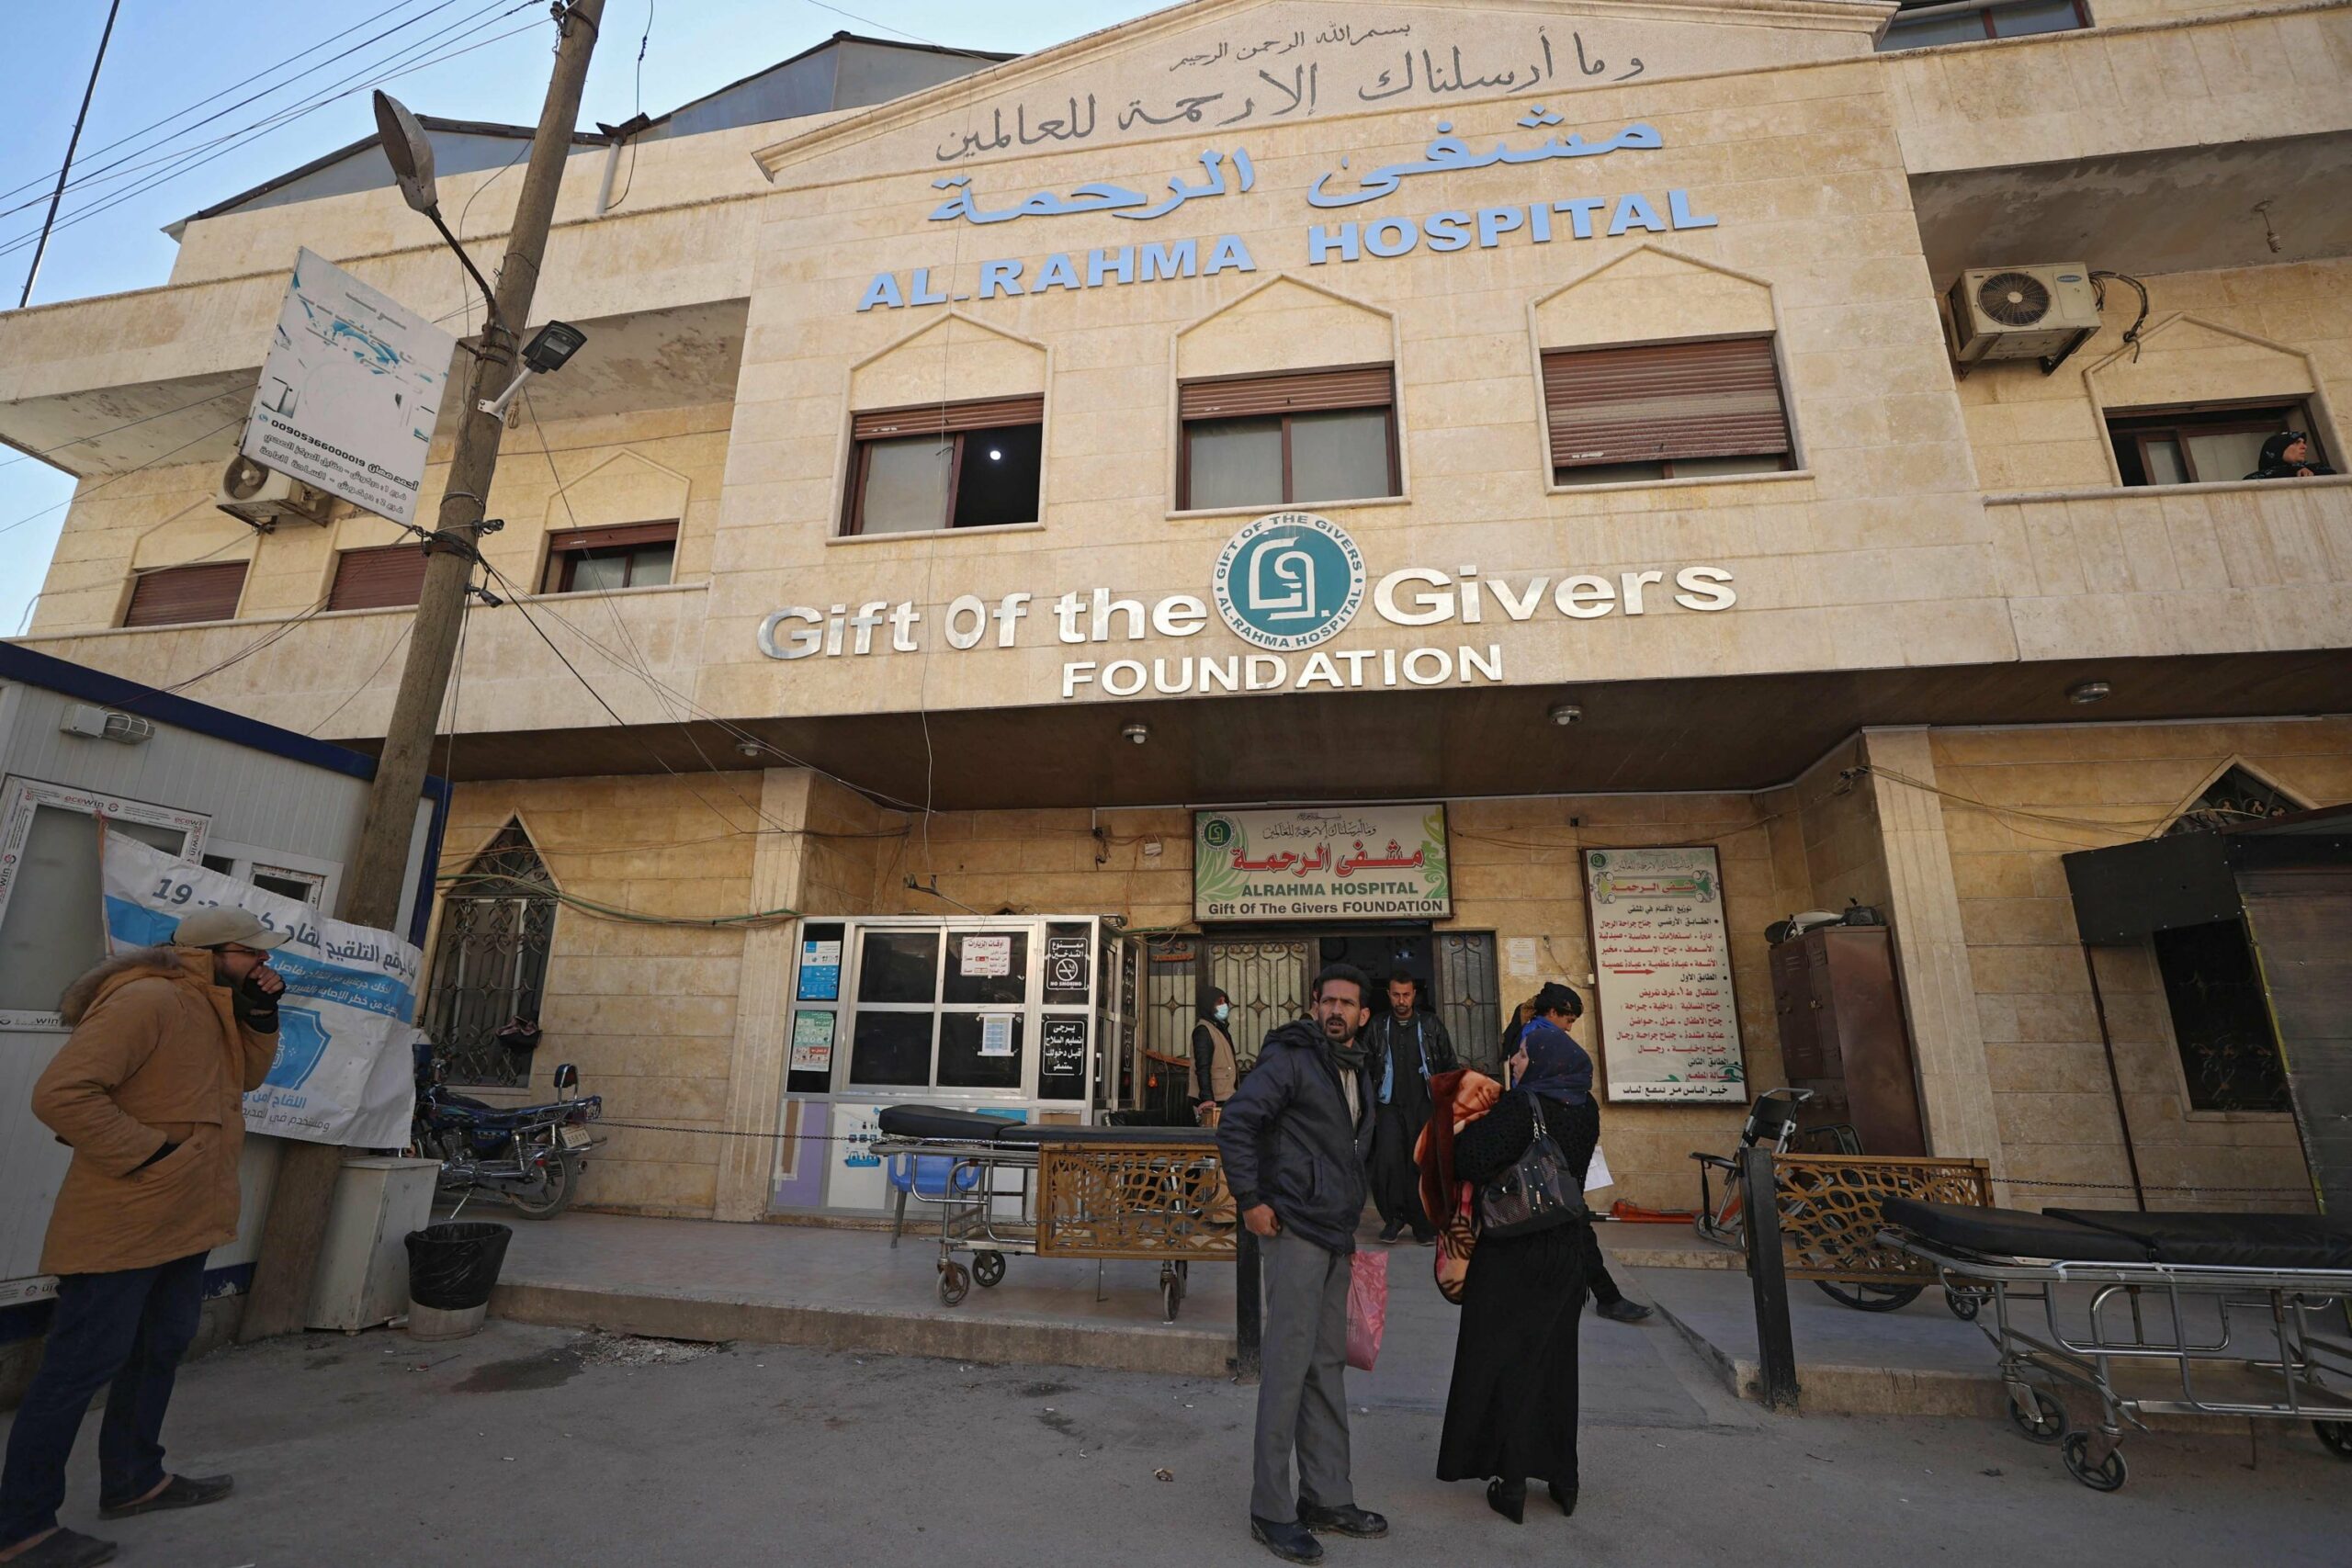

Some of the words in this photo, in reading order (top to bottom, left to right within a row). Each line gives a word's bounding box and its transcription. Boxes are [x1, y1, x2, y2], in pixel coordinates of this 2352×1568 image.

[1170, 42, 1227, 72] الرحيم
[1237, 30, 1305, 61] الرحمن
[1359, 26, 1554, 102] أرسلناك
[1117, 93, 1255, 130] رحمة
[935, 93, 1097, 162] للعالمين
[1307, 104, 1664, 209] مشفى
[928, 146, 1256, 225] الرحمة
[1307, 189, 1719, 265] HOSPITAL
[1241, 522, 1263, 539] OF
[1269, 513, 1309, 525] THE
[757, 599, 920, 660] Gift
[1054, 587, 1208, 643] the
[1374, 564, 1737, 626] Givers
[1062, 644, 1504, 698] FOUNDATION
[64, 794, 105, 809] ecewin
[1230, 842, 1332, 877] الرحمة
[1335, 839, 1424, 877] مشفى
[152, 878, 193, 905] 19
[1241, 883, 1326, 897] ALRAHMA
[1331, 881, 1419, 896] HOSPITAL
[1208, 901, 1236, 915] Gift
[1239, 901, 1259, 915] Of
[1261, 901, 1287, 914] The
[1291, 901, 1339, 914] Givers
[1342, 899, 1443, 913] FOUNDATION
[325, 940, 379, 964] التلقيح
[1051, 949, 1084, 960] التدخين
[1052, 940, 1084, 951] ممنوع
[243, 1106, 268, 1120] العدي
[272, 1093, 307, 1110] اللقاح
